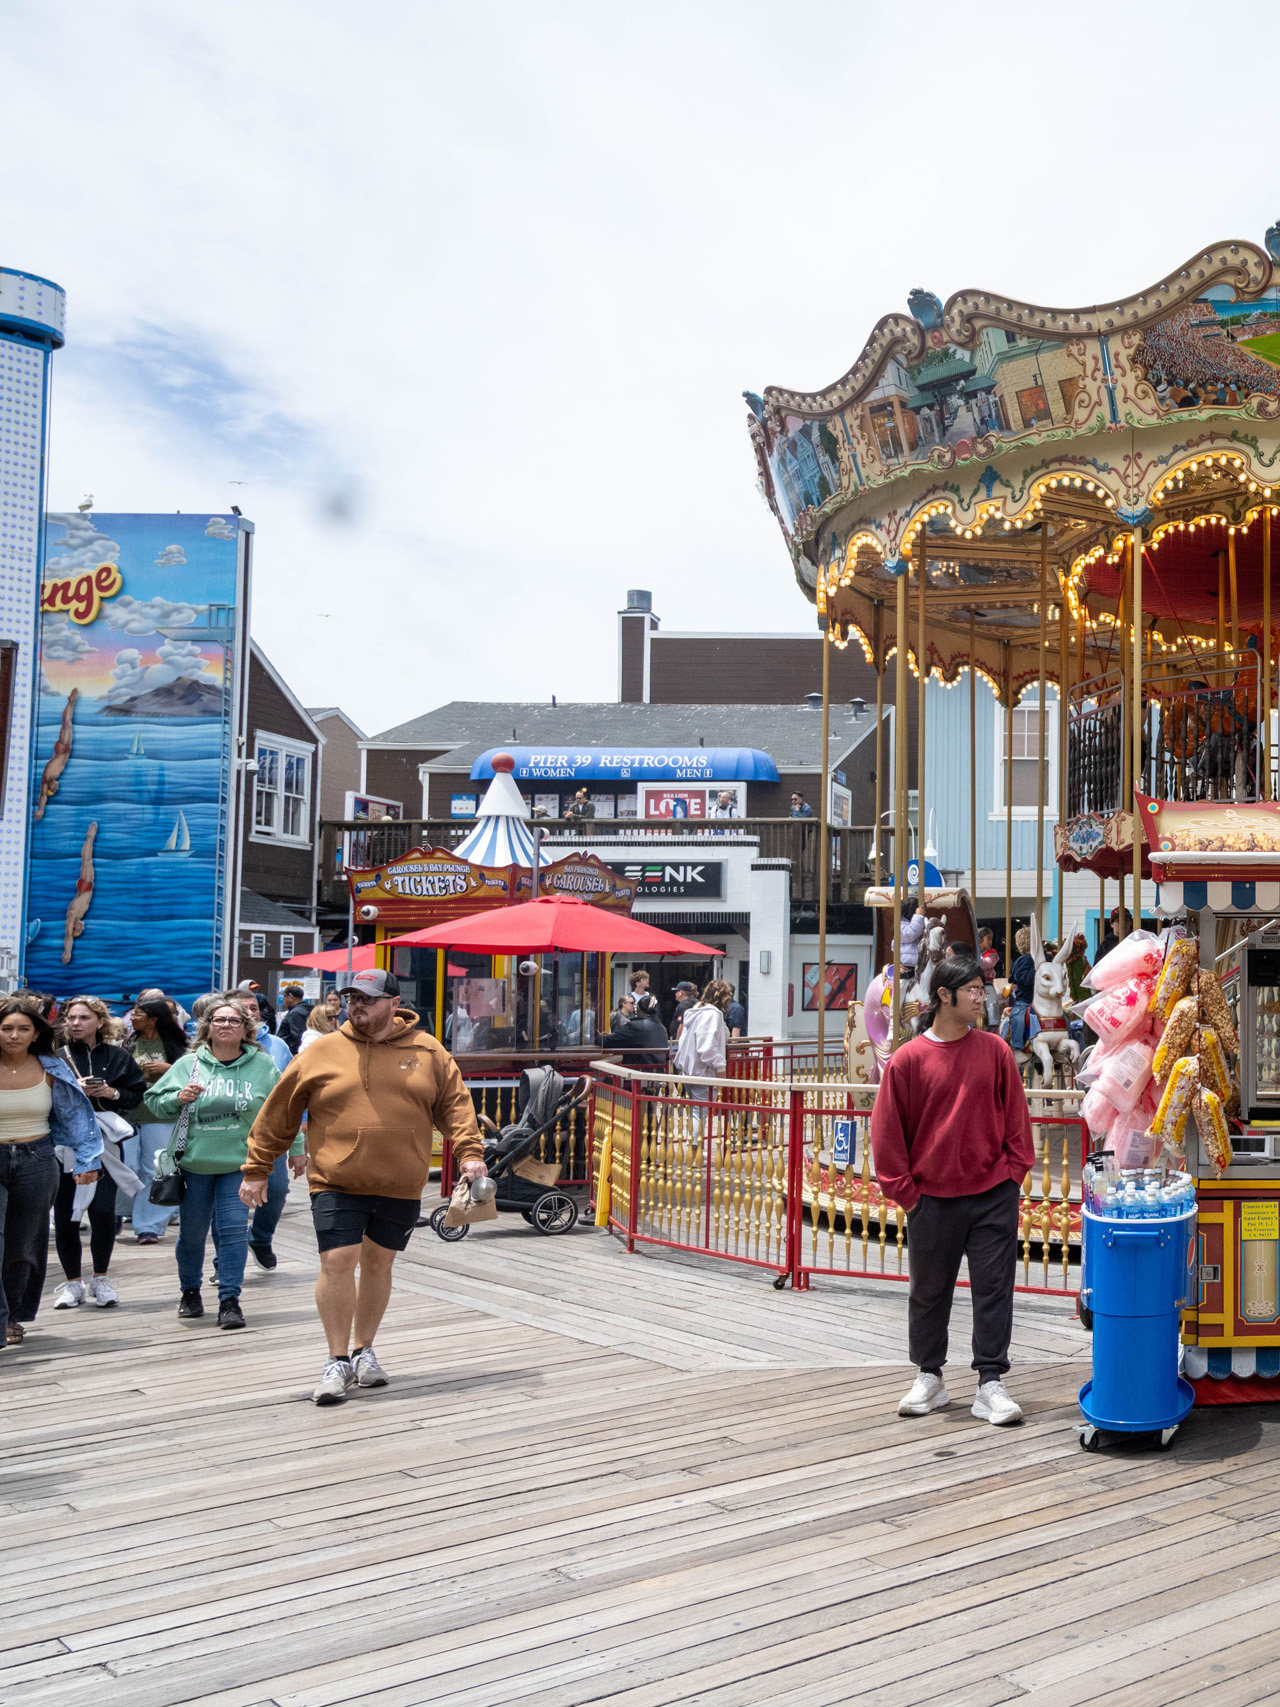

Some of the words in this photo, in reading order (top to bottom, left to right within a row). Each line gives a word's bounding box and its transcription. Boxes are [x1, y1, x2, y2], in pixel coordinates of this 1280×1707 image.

[528, 755, 568, 768] PIER
[571, 755, 591, 767] 39
[599, 755, 707, 768] RESTROOMS
[532, 767, 576, 778] WOMEN
[676, 768, 702, 778] MEN
[429, 863, 443, 873] BAY
[393, 874, 468, 897] TICKETS
[554, 874, 604, 892] CAROUSEL
